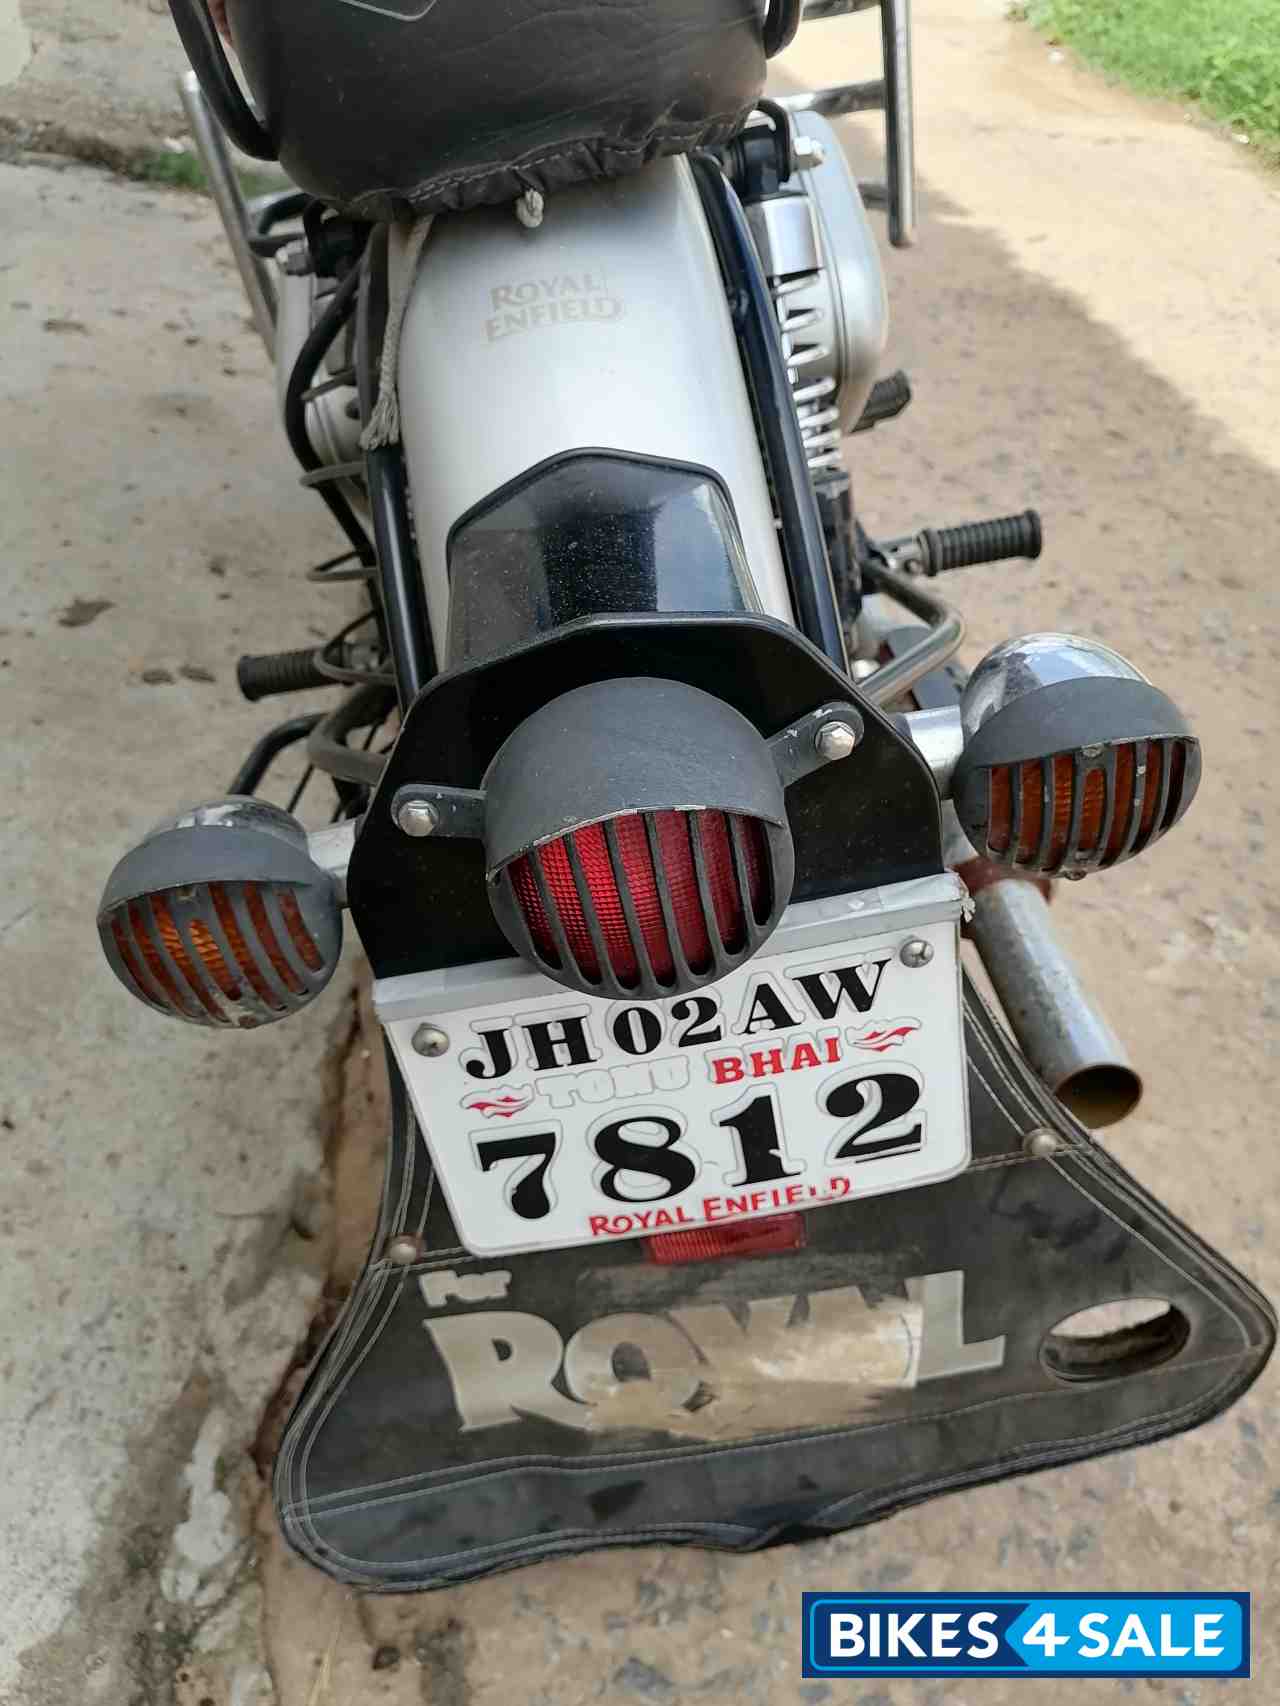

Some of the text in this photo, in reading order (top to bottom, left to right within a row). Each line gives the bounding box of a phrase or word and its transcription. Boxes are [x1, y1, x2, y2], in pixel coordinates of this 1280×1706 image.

[490, 271, 607, 312] ROYAL
[482, 296, 626, 343] ENFIELD
[712, 1036, 843, 1085] BHAI
[476, 1071, 922, 1220] 7812
[588, 1206, 696, 1236] ROYAL
